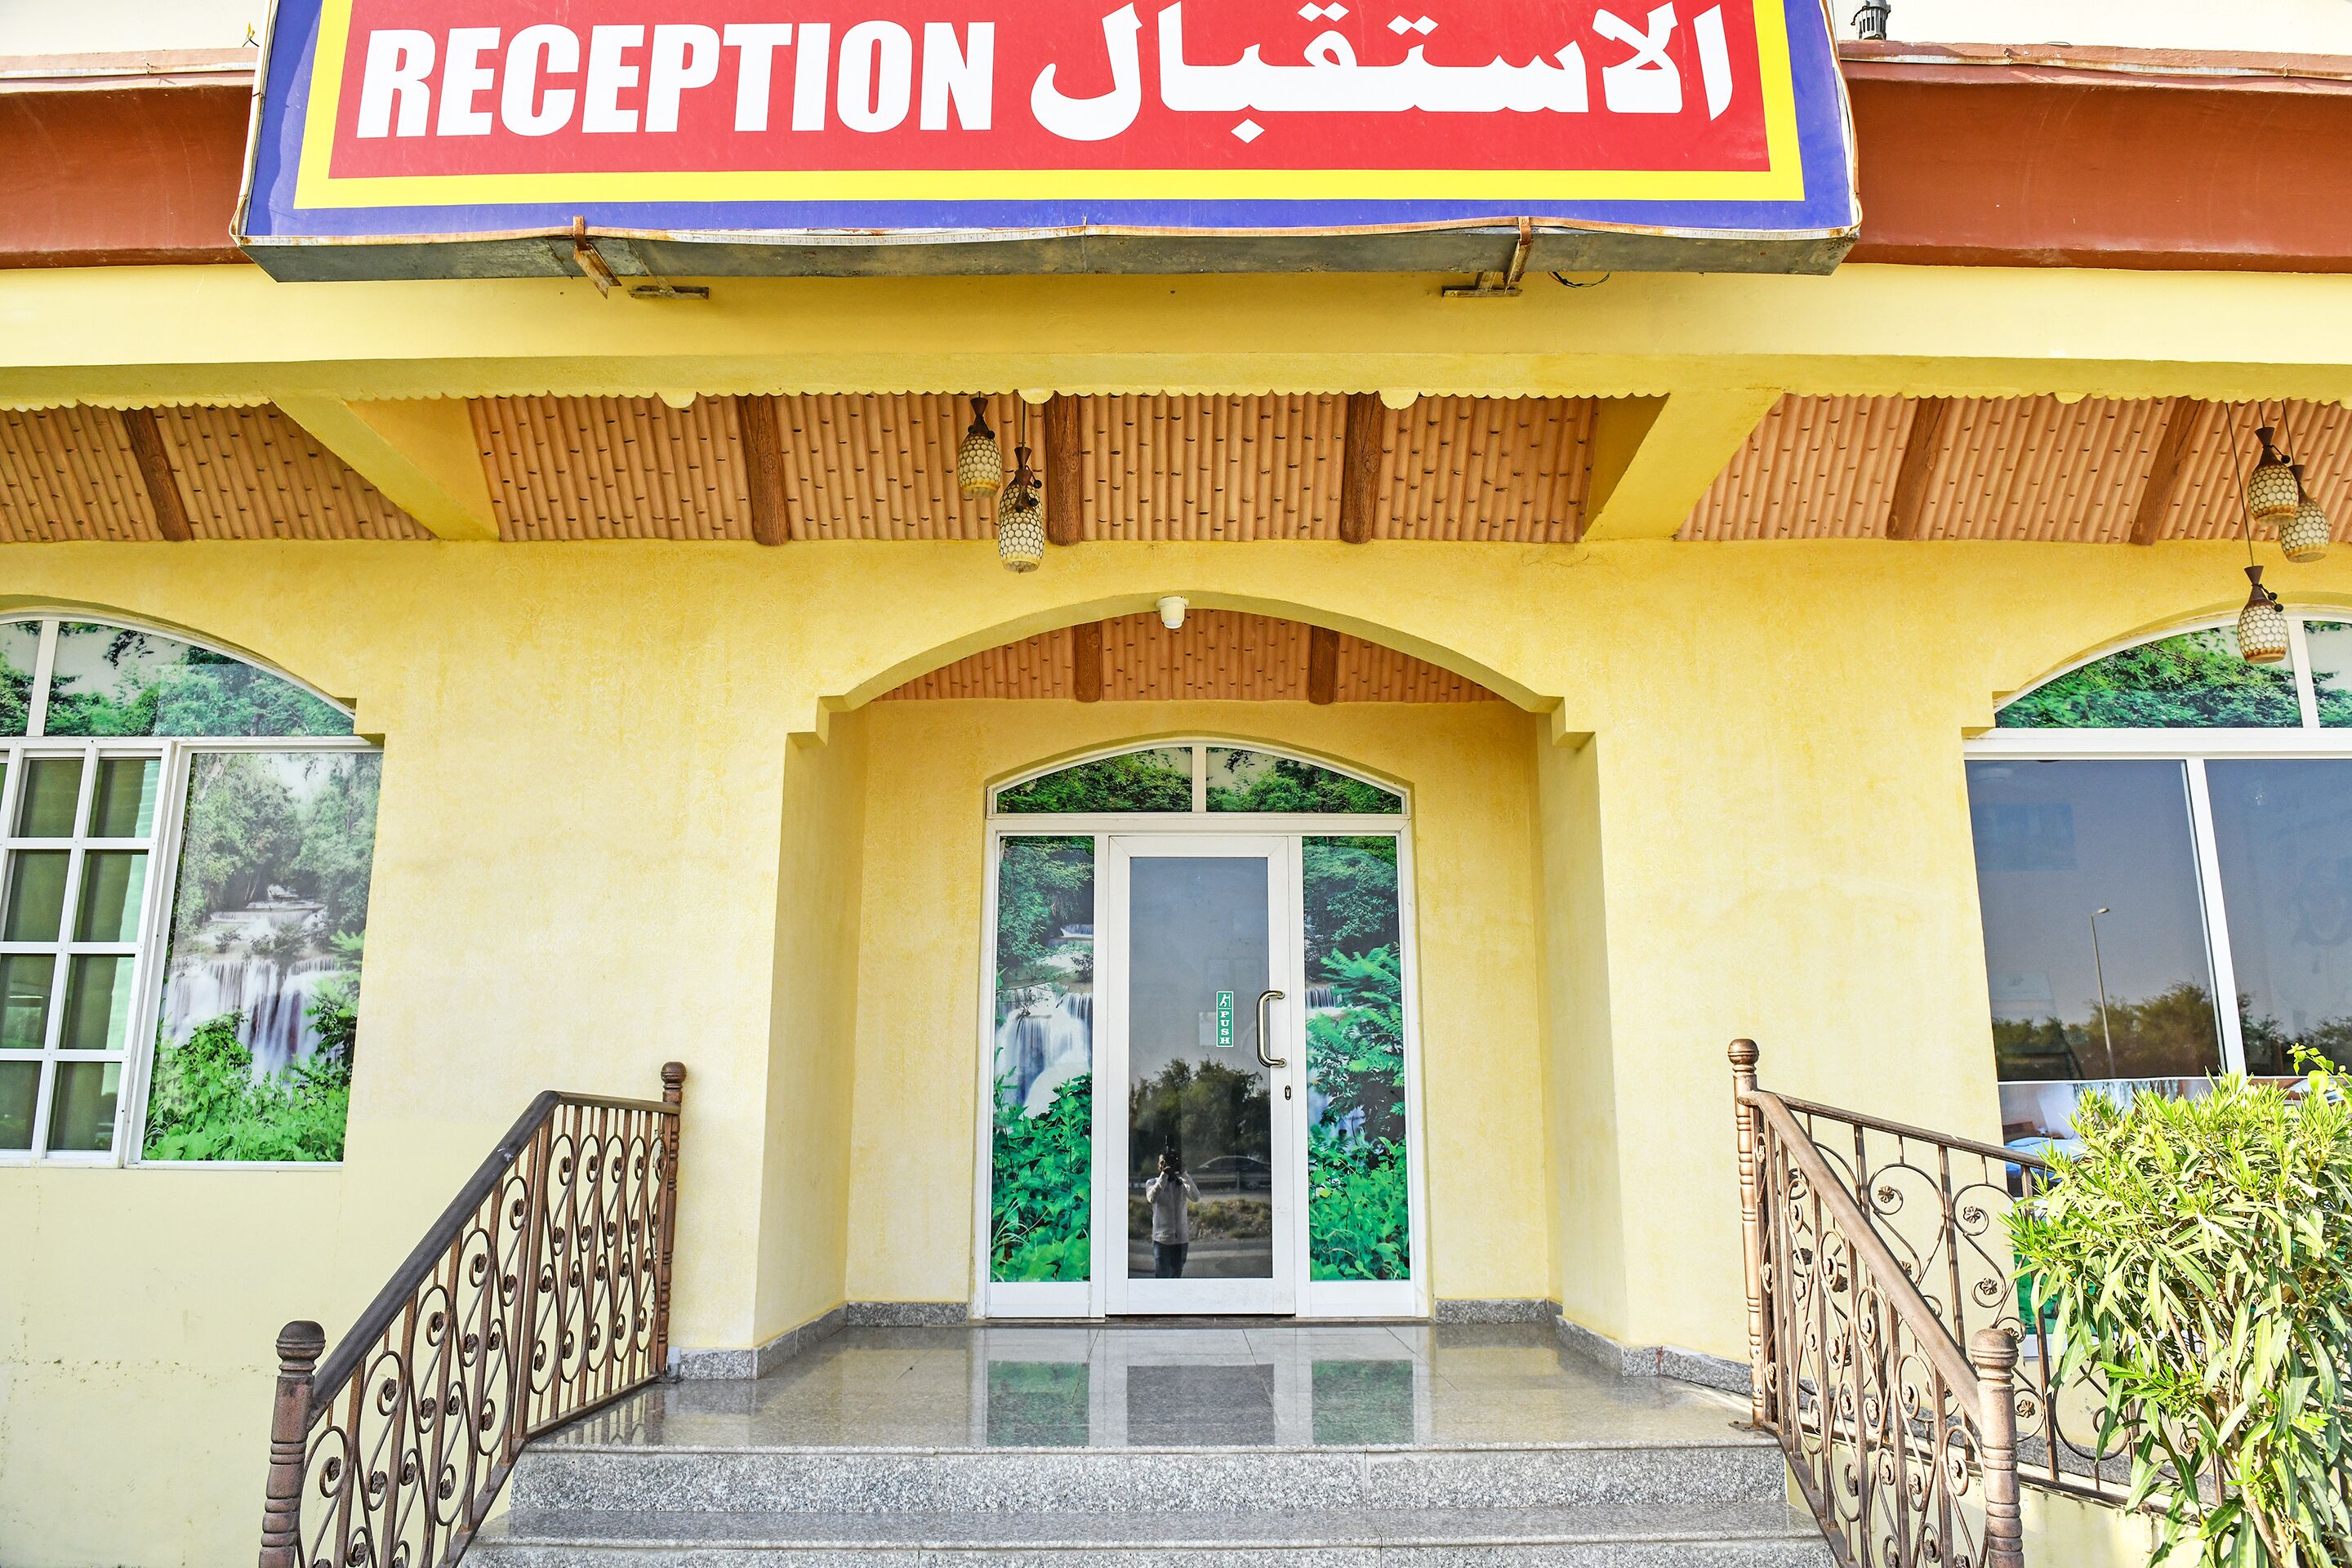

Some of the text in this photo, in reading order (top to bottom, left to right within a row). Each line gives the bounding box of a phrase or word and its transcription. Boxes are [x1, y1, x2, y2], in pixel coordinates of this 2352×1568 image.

[356, 20, 996, 139] RECEPTION
[1031, 1, 1733, 144] الاستقبال
[1219, 1011, 1231, 1044] PUSH
